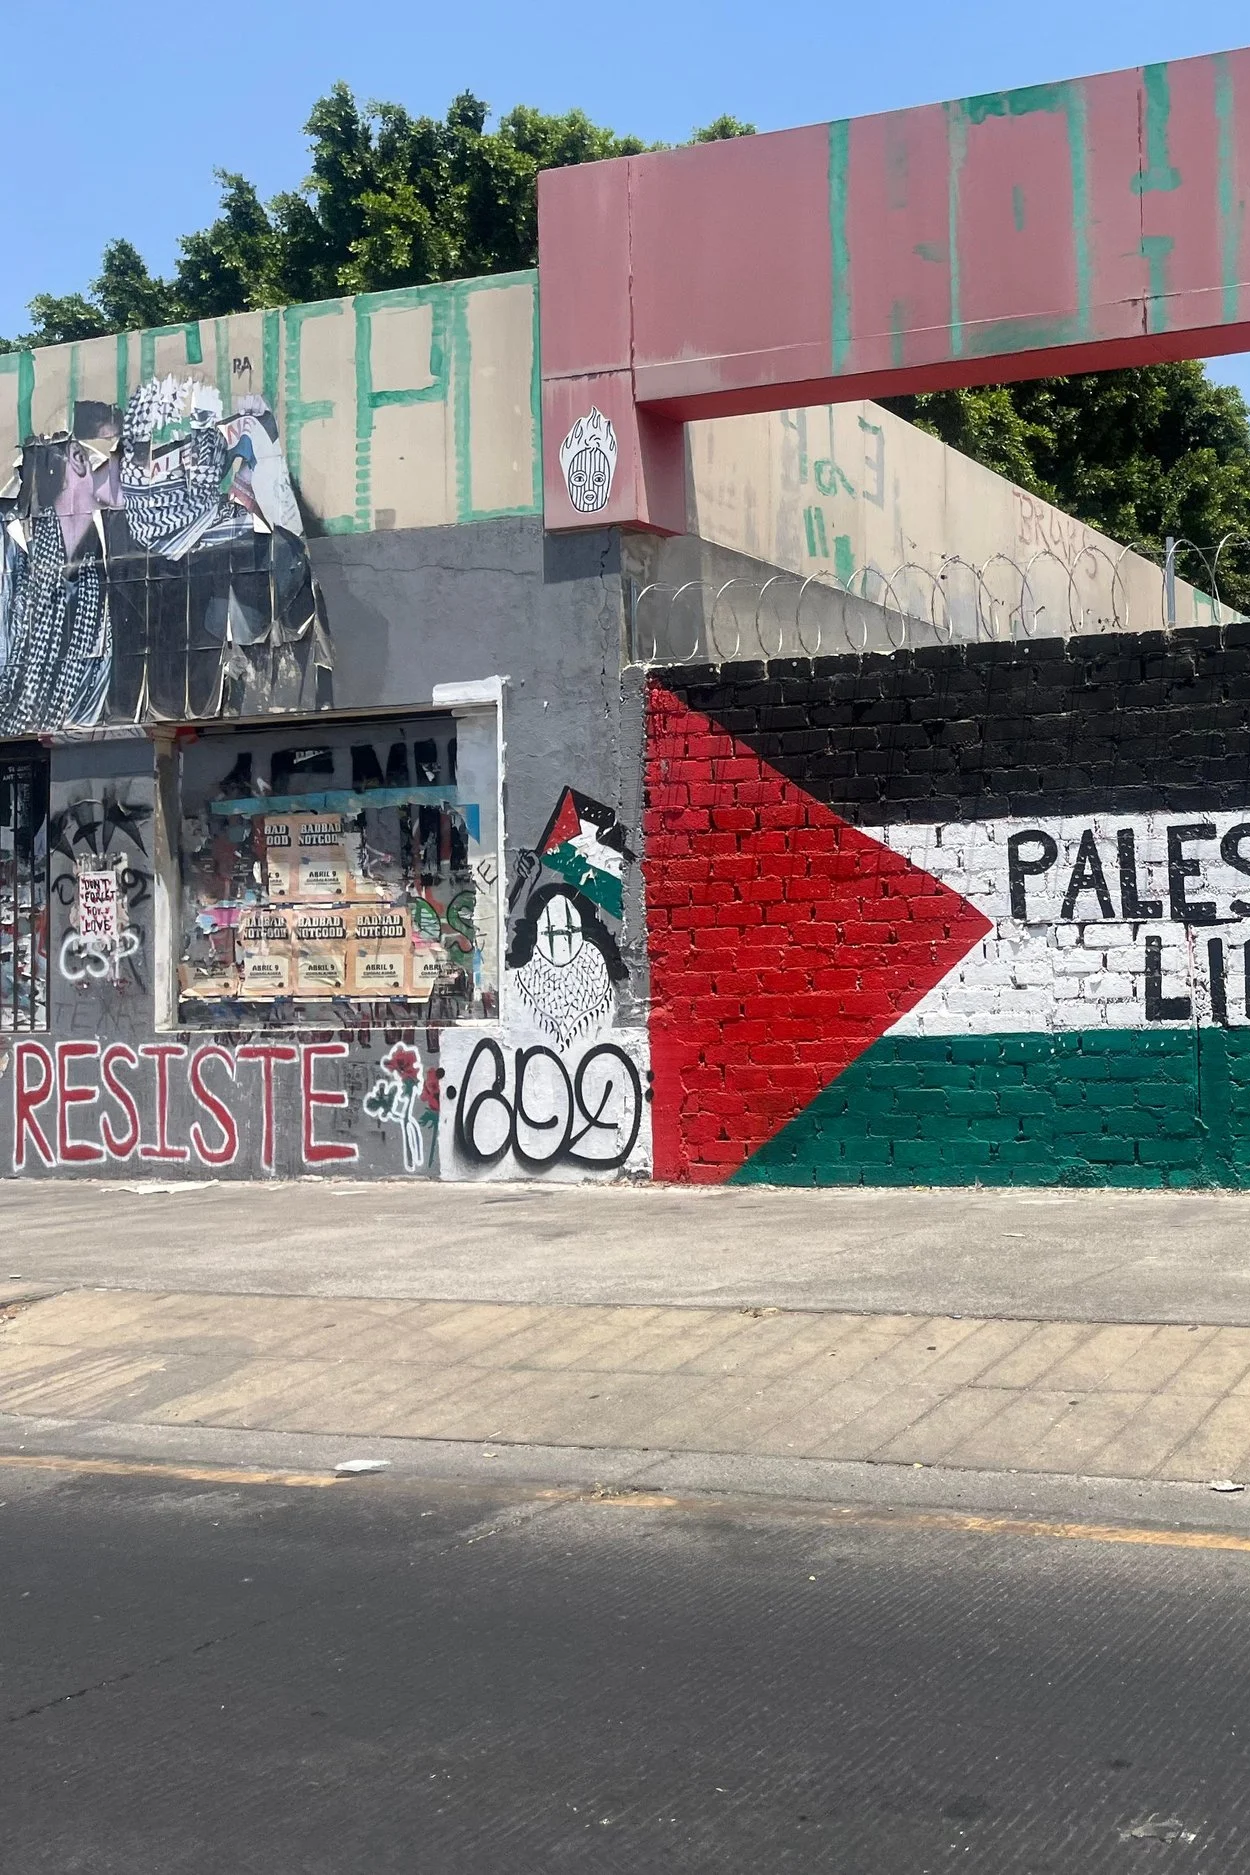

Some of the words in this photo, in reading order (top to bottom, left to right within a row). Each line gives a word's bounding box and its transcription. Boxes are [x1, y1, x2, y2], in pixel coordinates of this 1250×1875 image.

[298, 916, 343, 927] BADBAD
[355, 926, 406, 939] NOTGOOD
[13, 1040, 359, 1173] RESISTE
